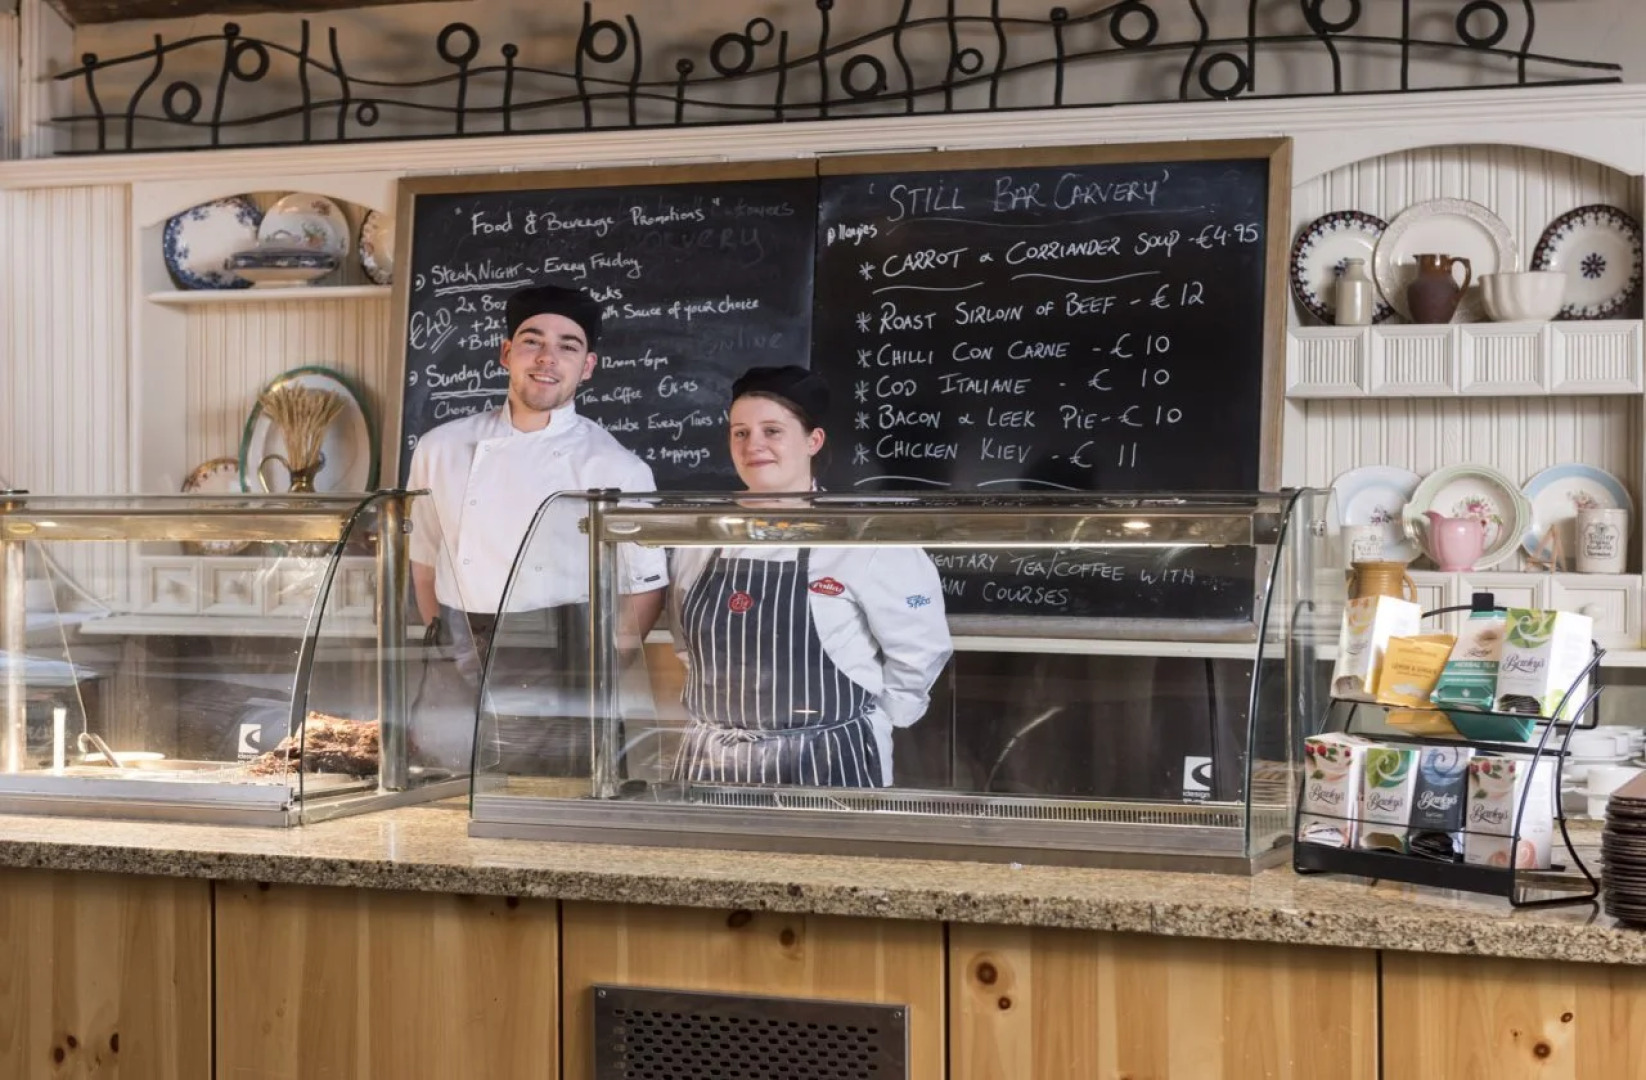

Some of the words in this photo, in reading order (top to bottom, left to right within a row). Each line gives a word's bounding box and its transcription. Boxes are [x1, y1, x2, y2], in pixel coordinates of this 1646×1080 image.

[887, 181, 965, 222] STILL
[993, 176, 1046, 213] BAR
[472, 210, 513, 236] Food
[540, 211, 615, 237] Beverage
[431, 262, 477, 286] Steak
[543, 257, 588, 281] Every
[590, 252, 642, 279] Friday
[881, 247, 969, 277] CARROT
[1005, 236, 1121, 265] CORRIANDER
[455, 296, 477, 314] 2x
[623, 303, 662, 319] Sauce
[668, 300, 681, 320] of
[718, 294, 760, 313] choice
[878, 301, 937, 335] ROAST
[954, 301, 1024, 325] SIRLOIN
[1065, 292, 1118, 317] BEEF
[876, 342, 934, 366] CHILLI
[952, 341, 994, 361] CON
[1007, 340, 1071, 360] CARNE
[425, 363, 482, 392] Sunday
[876, 375, 918, 398] COD
[937, 372, 1032, 396] ITALIANE
[878, 404, 941, 430] BACON
[986, 407, 1036, 428] LEEK
[660, 446, 711, 469] toppings
[876, 434, 959, 460] CHICKEN
[980, 437, 1032, 464] KIEV
[1140, 568, 1196, 585] WITH
[981, 581, 1070, 606] COURSES
